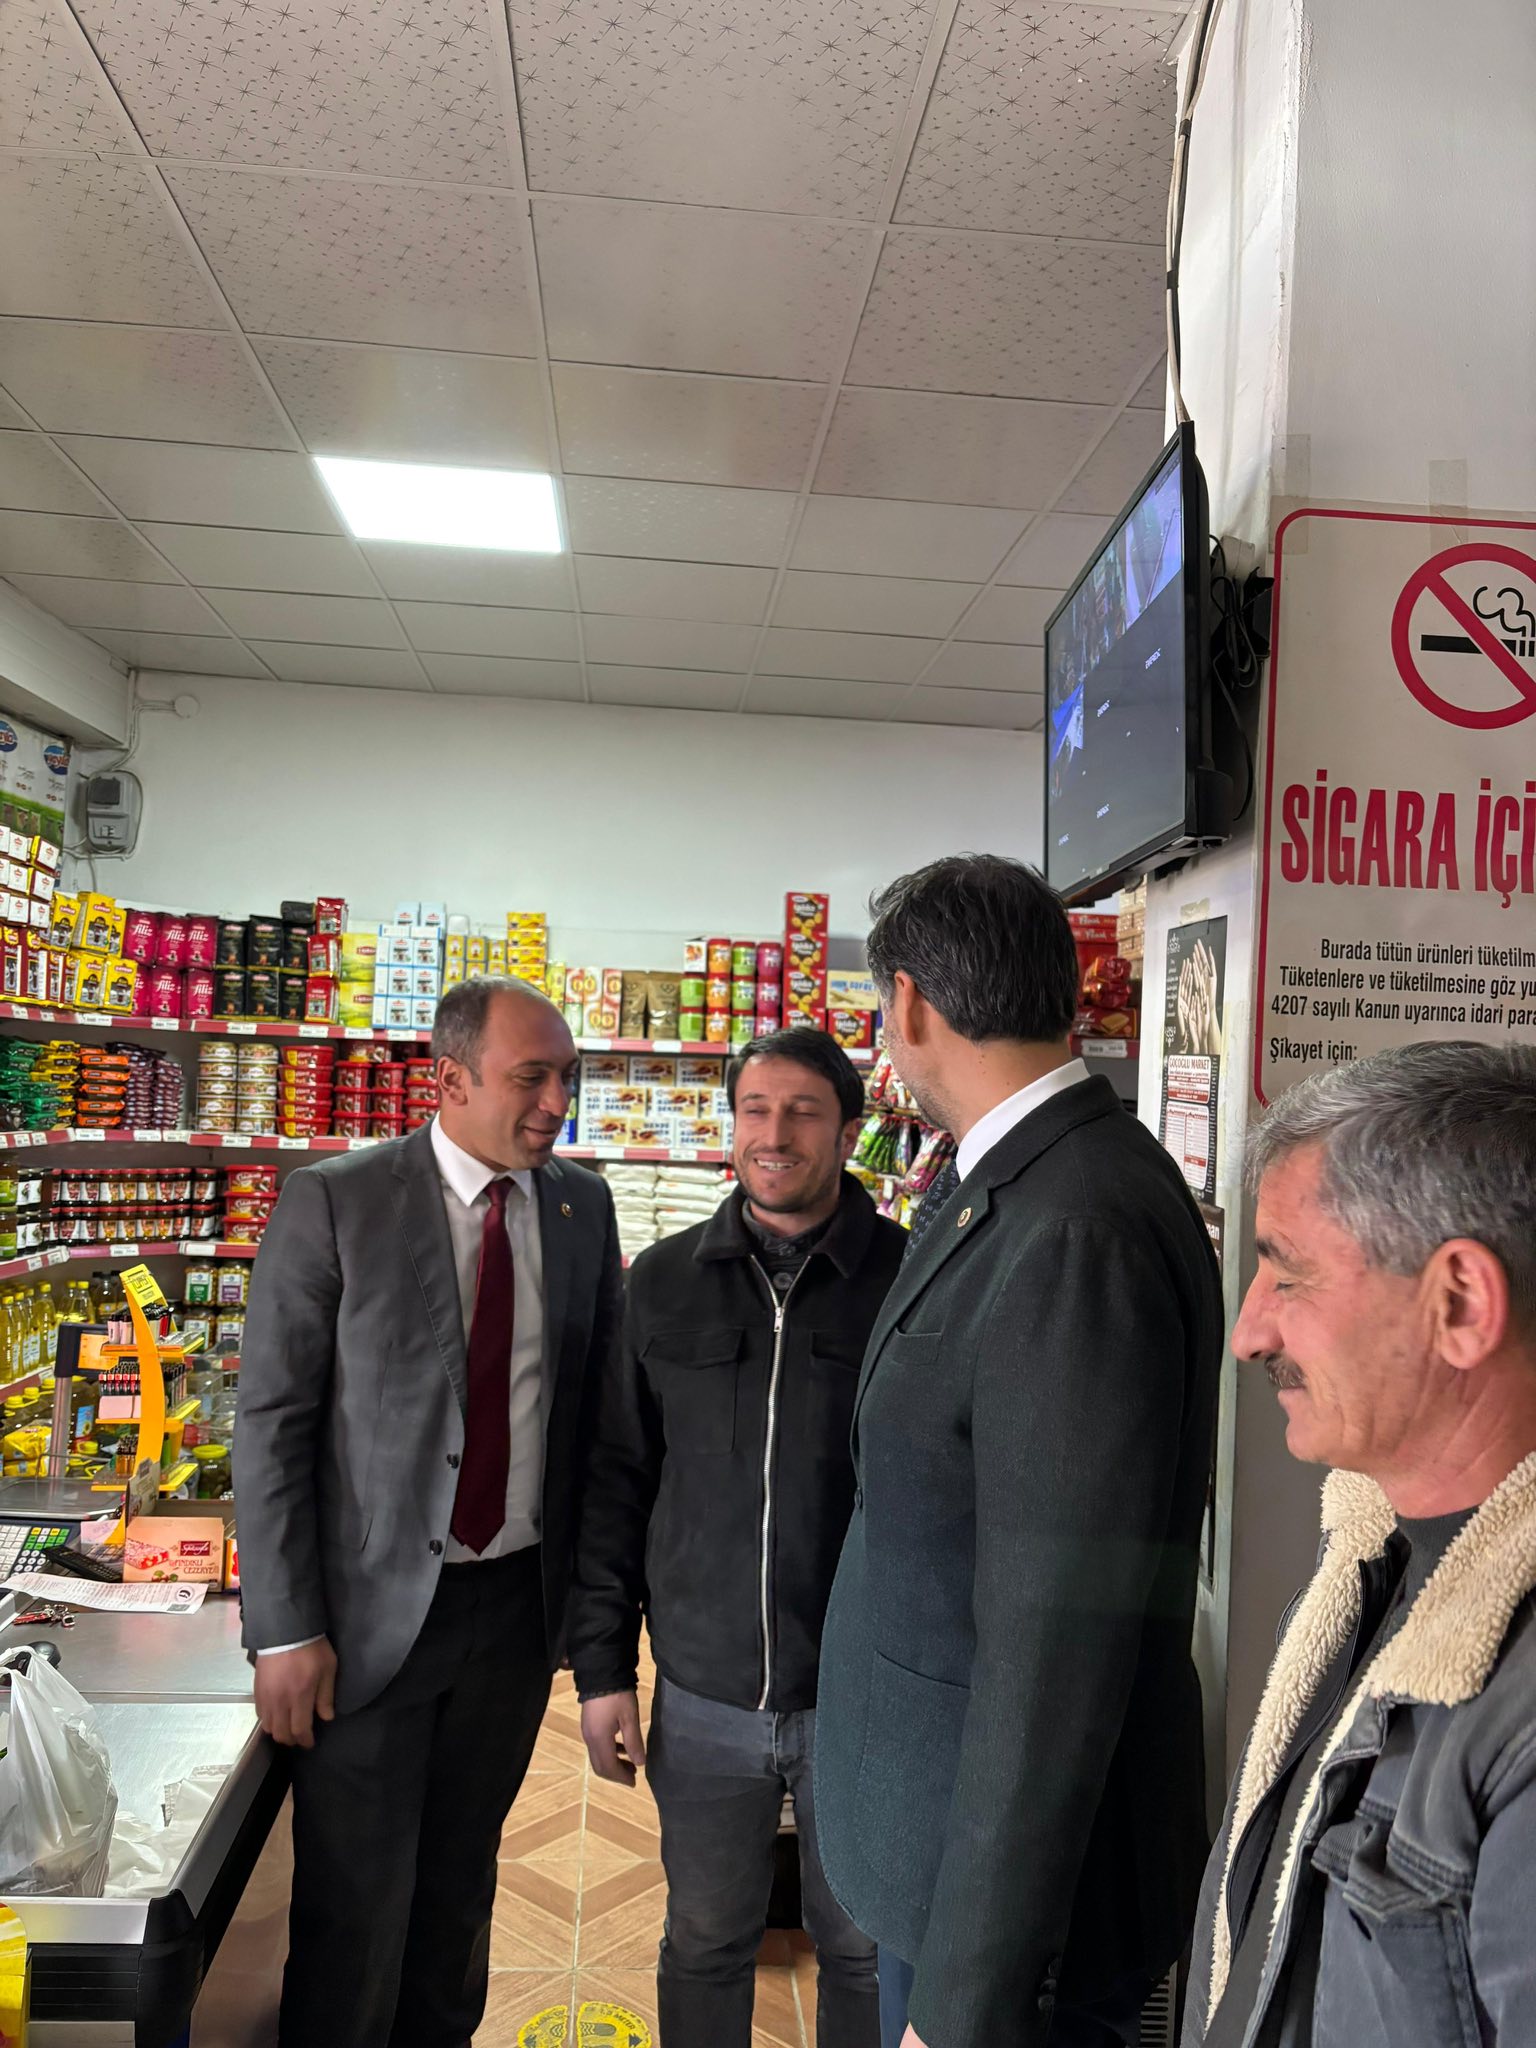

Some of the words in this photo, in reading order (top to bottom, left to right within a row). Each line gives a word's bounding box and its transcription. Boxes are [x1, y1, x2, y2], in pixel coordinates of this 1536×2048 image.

[1281, 769, 1460, 891] SİGARA
[1321, 938, 1371, 960] Burada
[1376, 941, 1412, 962] tütün
[1417, 942, 1473, 965] ürünleri
[1478, 945, 1536, 968] tüketilm
[1280, 965, 1364, 989] Tüketenlere
[1369, 973, 1385, 990] ve
[1390, 970, 1485, 994] tüketilmesine
[1490, 975, 1516, 999] göz
[1271, 994, 1308, 1016] 4207
[1312, 997, 1350, 1021] sayılı
[1355, 998, 1399, 1019] Kanun
[1404, 1004, 1466, 1025] uyarınca
[1471, 1003, 1503, 1024] idari
[1270, 1036, 1323, 1063] Şikayet
[1327, 1040, 1357, 1066] için:
